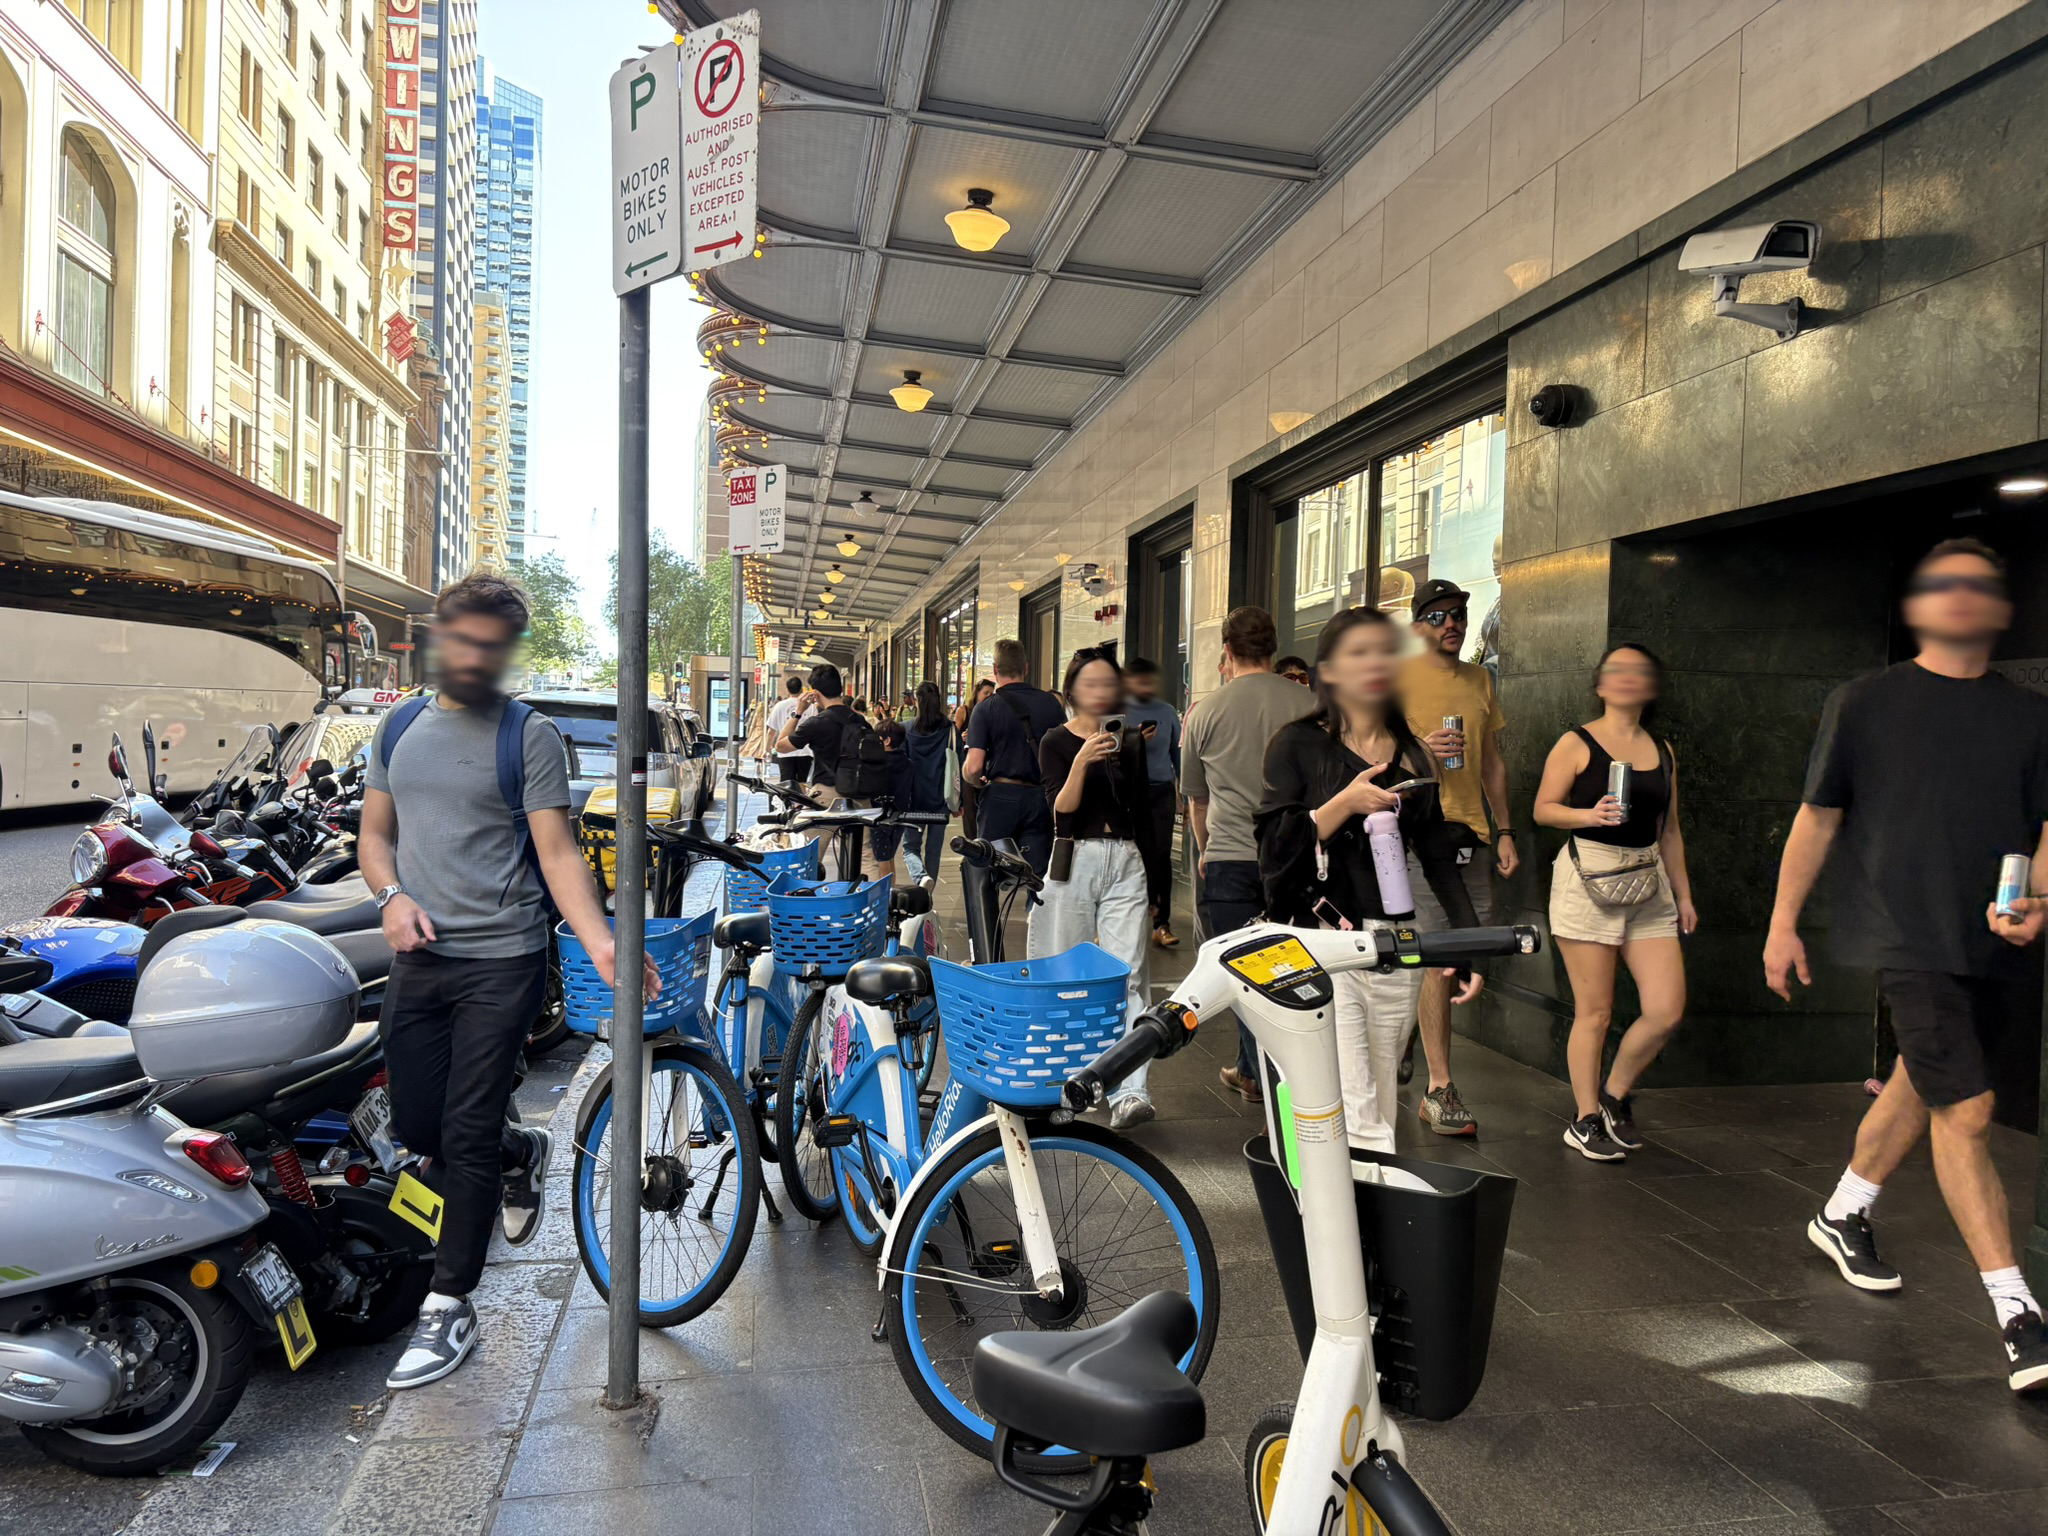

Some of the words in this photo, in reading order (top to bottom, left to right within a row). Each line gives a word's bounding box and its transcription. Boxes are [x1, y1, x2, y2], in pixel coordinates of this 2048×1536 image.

[630, 72, 656, 132] P
[685, 113, 753, 146] AUTHORISED
[707, 139, 729, 157] AND
[620, 157, 670, 198] MOTOR
[687, 161, 717, 181] AUST.
[721, 150, 749, 171] POST
[692, 171, 744, 197] VEHICLES
[623, 184, 667, 222] BIKES
[690, 189, 745, 216] EXCEPTED
[627, 209, 667, 243] ONLY
[732, 477, 755, 491] TAXI
[765, 472, 777, 494] P
[731, 491, 755, 505] ZONE
[759, 507, 782, 518] MOTOR
[760, 517, 780, 527] BIKES
[761, 527, 779, 537] ONLY
[400, 1197, 441, 1227] L
[280, 1307, 309, 1356] L
